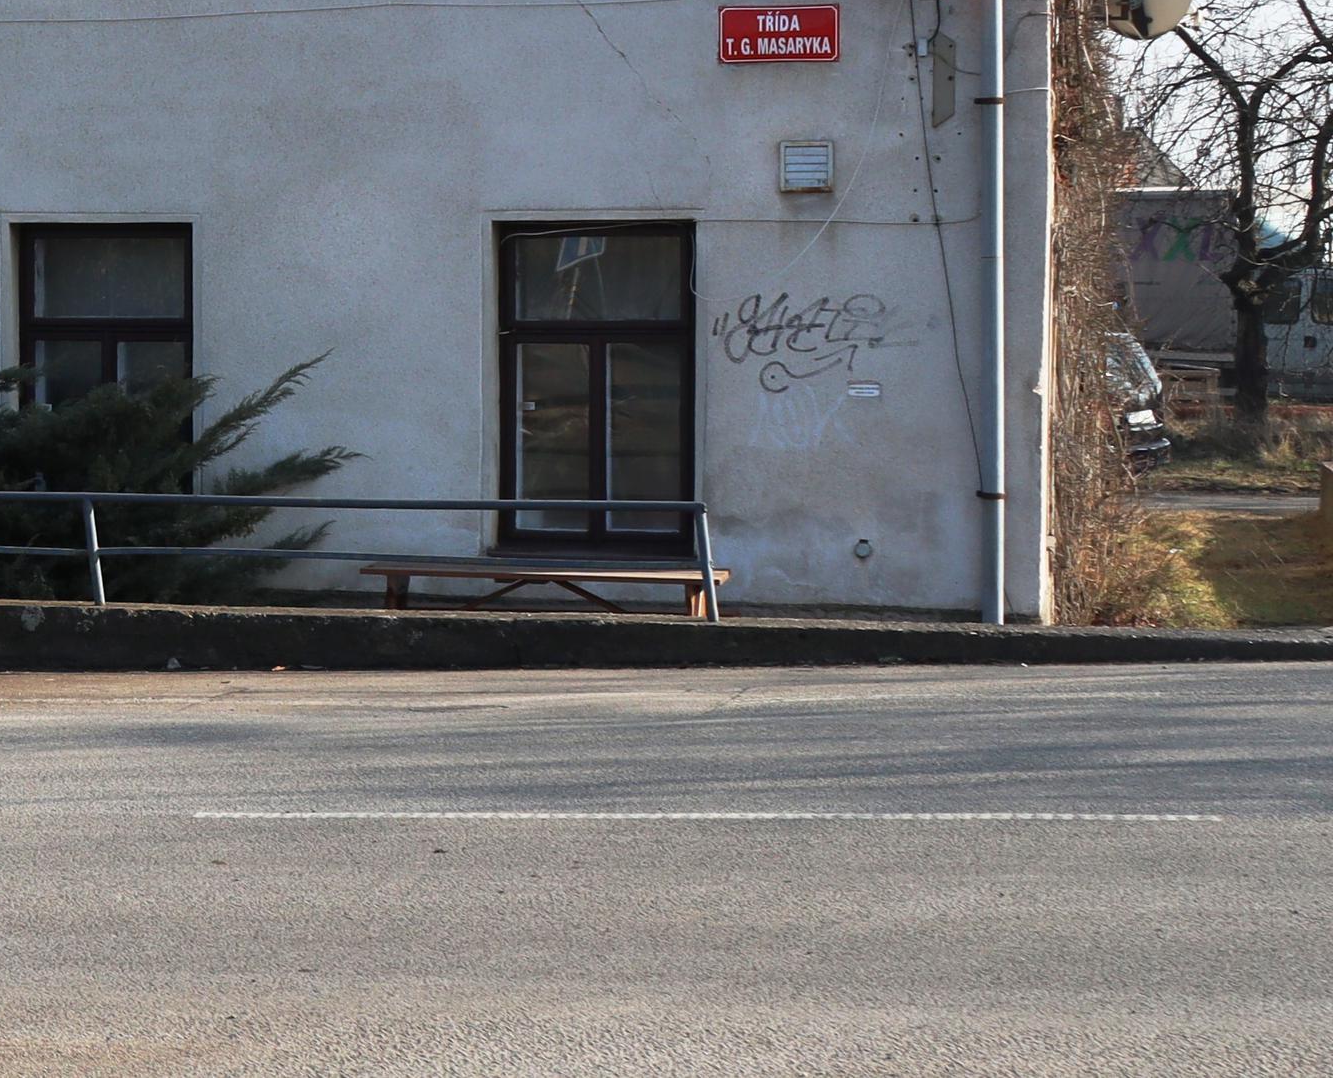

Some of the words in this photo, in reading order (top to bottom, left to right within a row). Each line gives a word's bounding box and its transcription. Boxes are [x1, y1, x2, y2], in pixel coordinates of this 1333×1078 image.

[756, 11, 800, 32] TŘÍDA
[726, 38, 738, 56] T.
[740, 37, 755, 55] G.
[757, 36, 832, 55] MASARYKA
